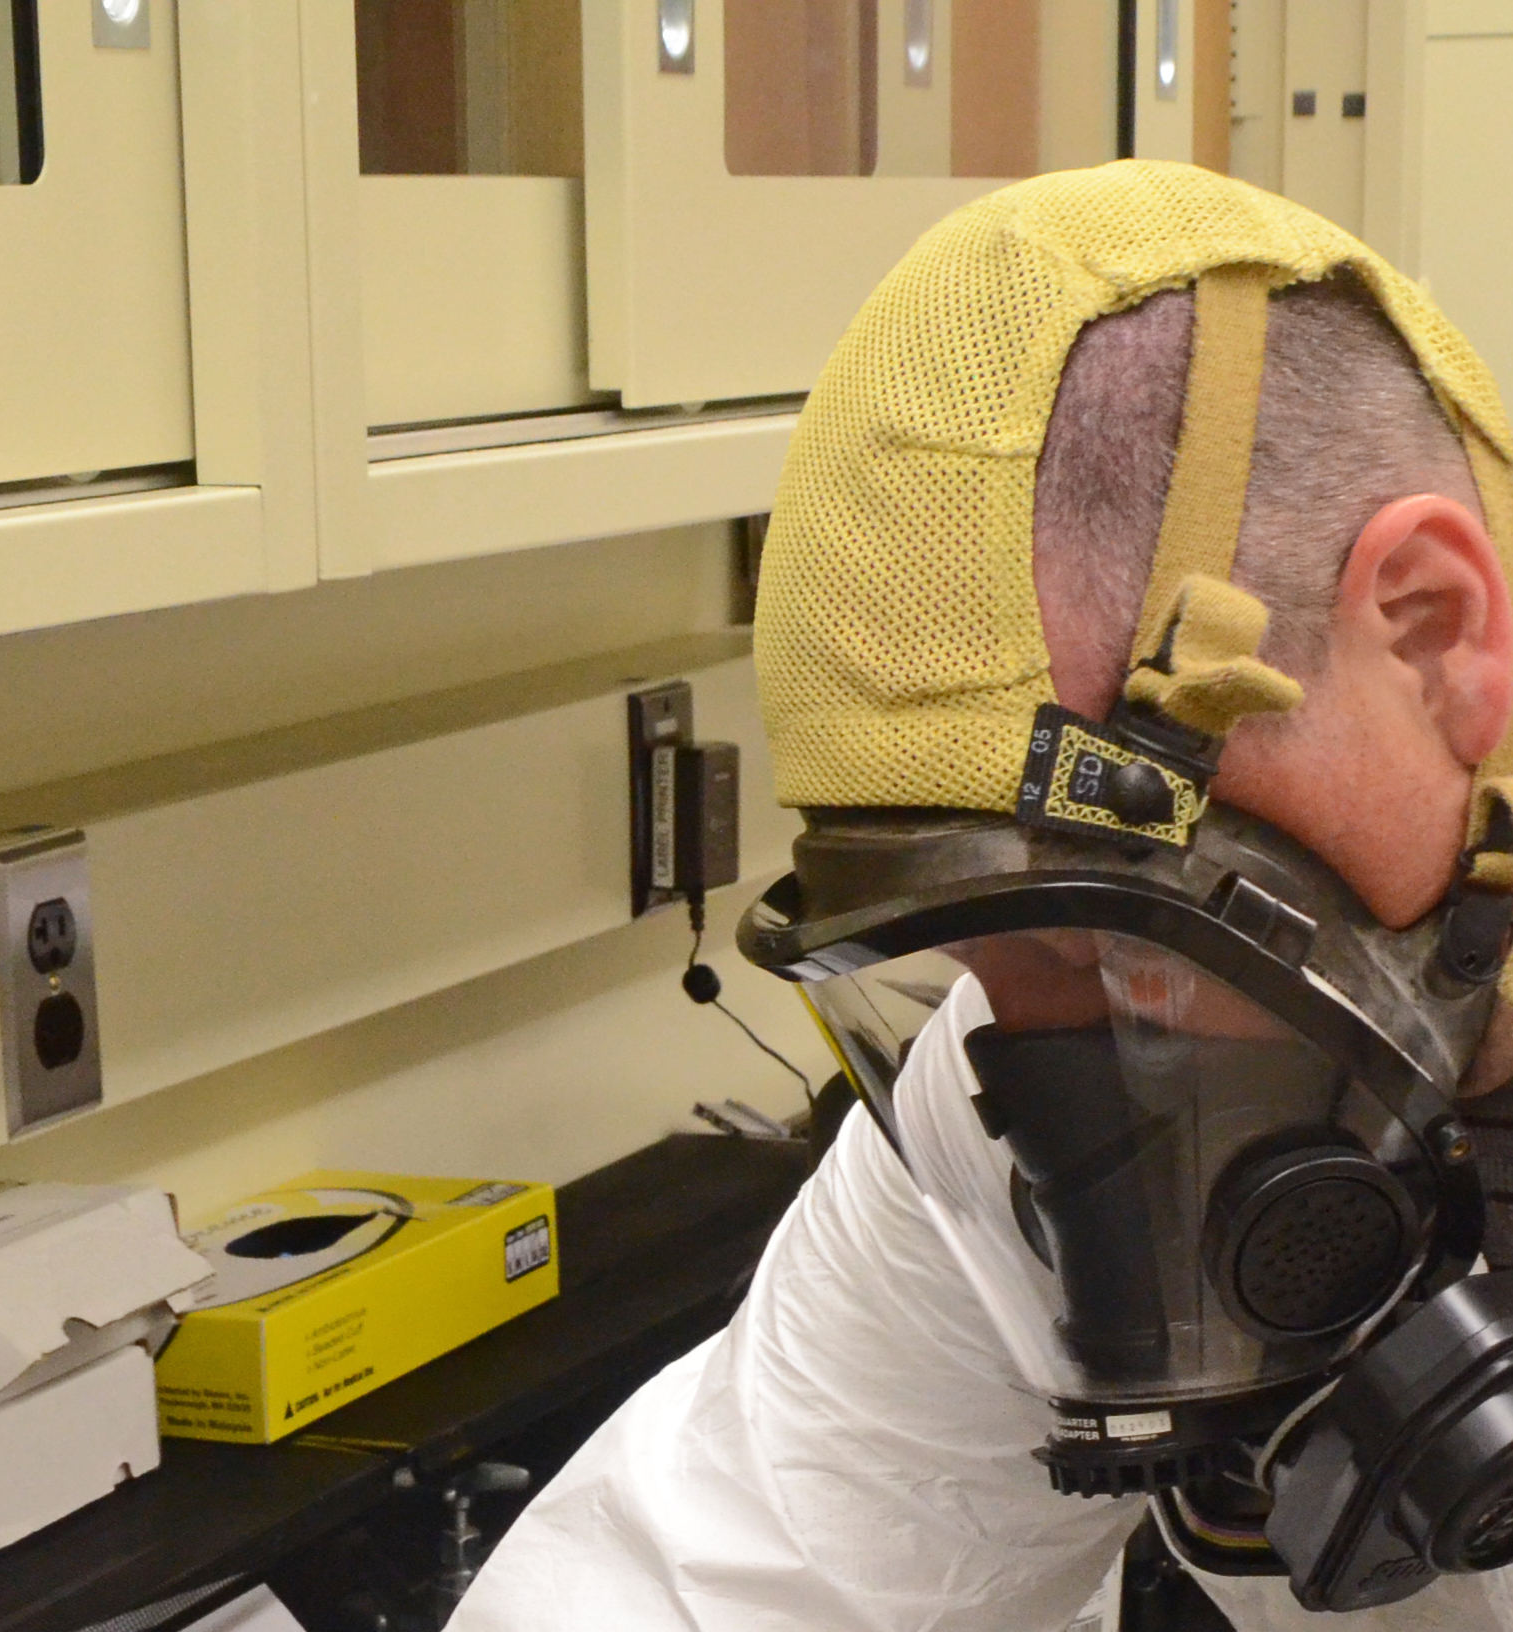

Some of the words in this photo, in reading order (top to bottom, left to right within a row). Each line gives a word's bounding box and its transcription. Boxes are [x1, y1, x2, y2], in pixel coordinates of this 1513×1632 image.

[1030, 728, 1052, 753] 05
[1075, 755, 1104, 797] SD
[1023, 782, 1041, 801] 12
